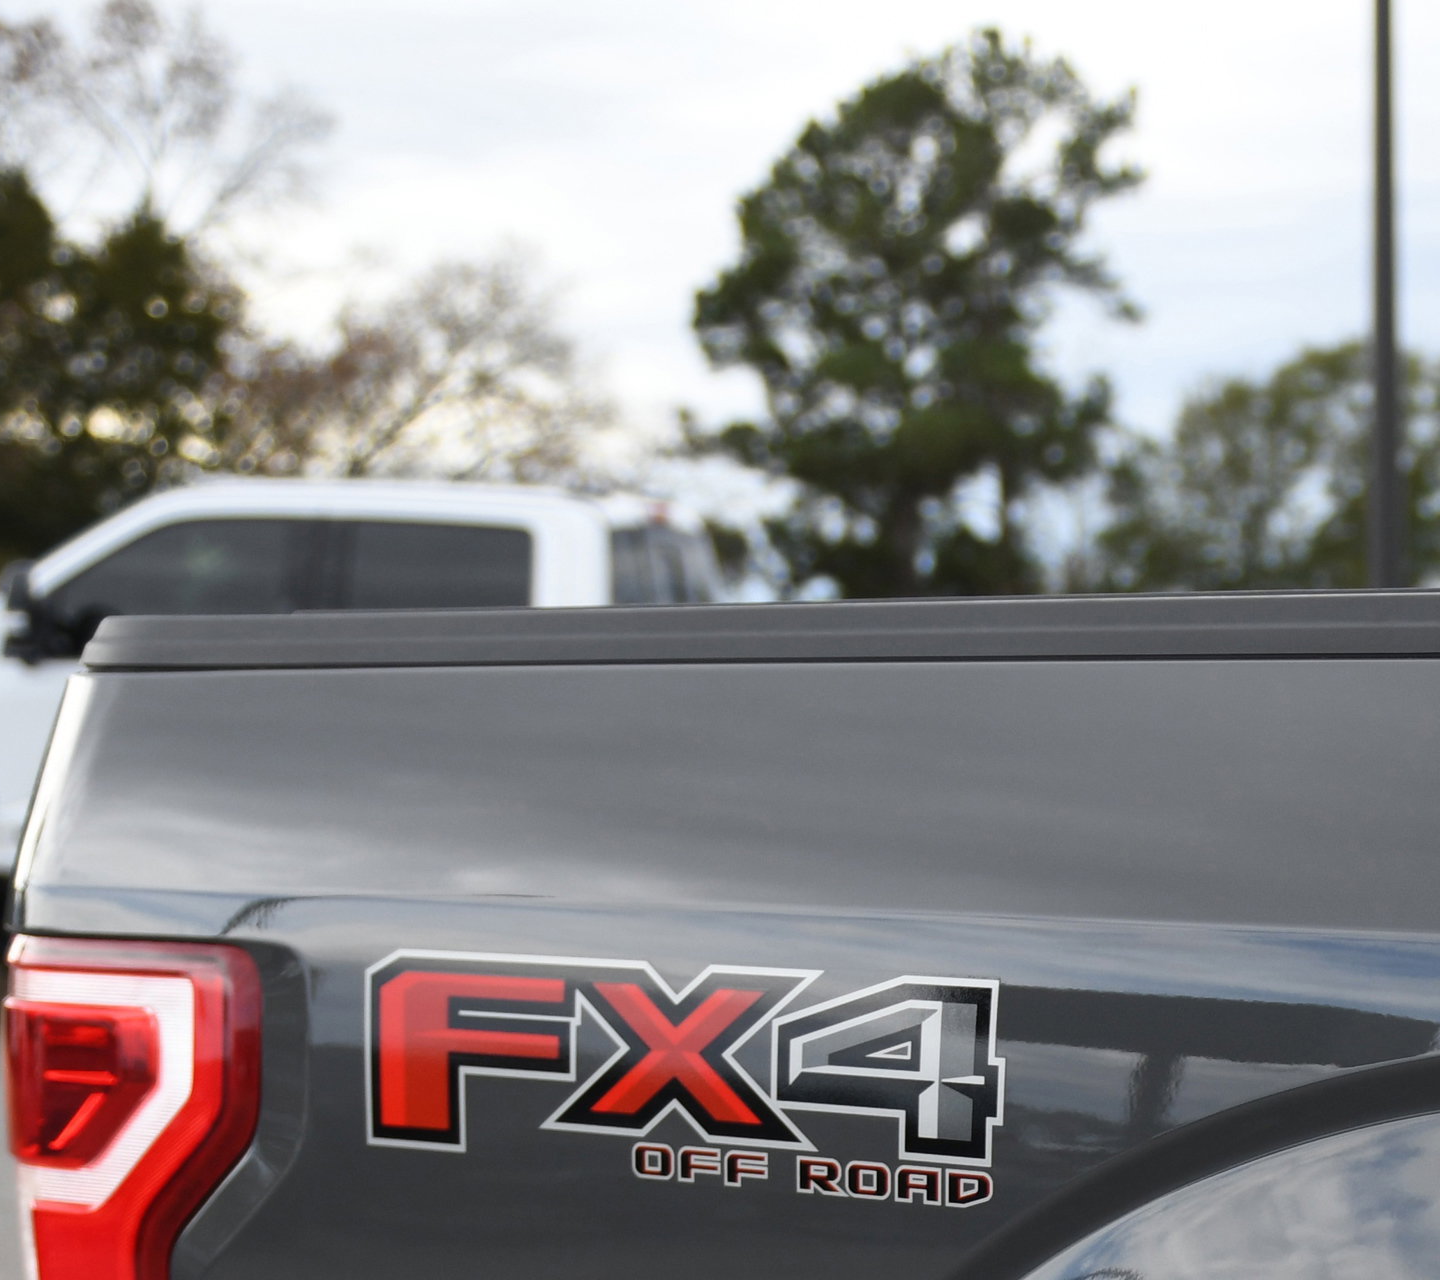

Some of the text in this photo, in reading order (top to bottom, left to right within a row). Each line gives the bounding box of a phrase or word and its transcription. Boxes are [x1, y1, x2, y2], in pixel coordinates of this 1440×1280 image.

[365, 948, 1005, 1167] FX4
[632, 1141, 993, 1208] OFF ROAD
